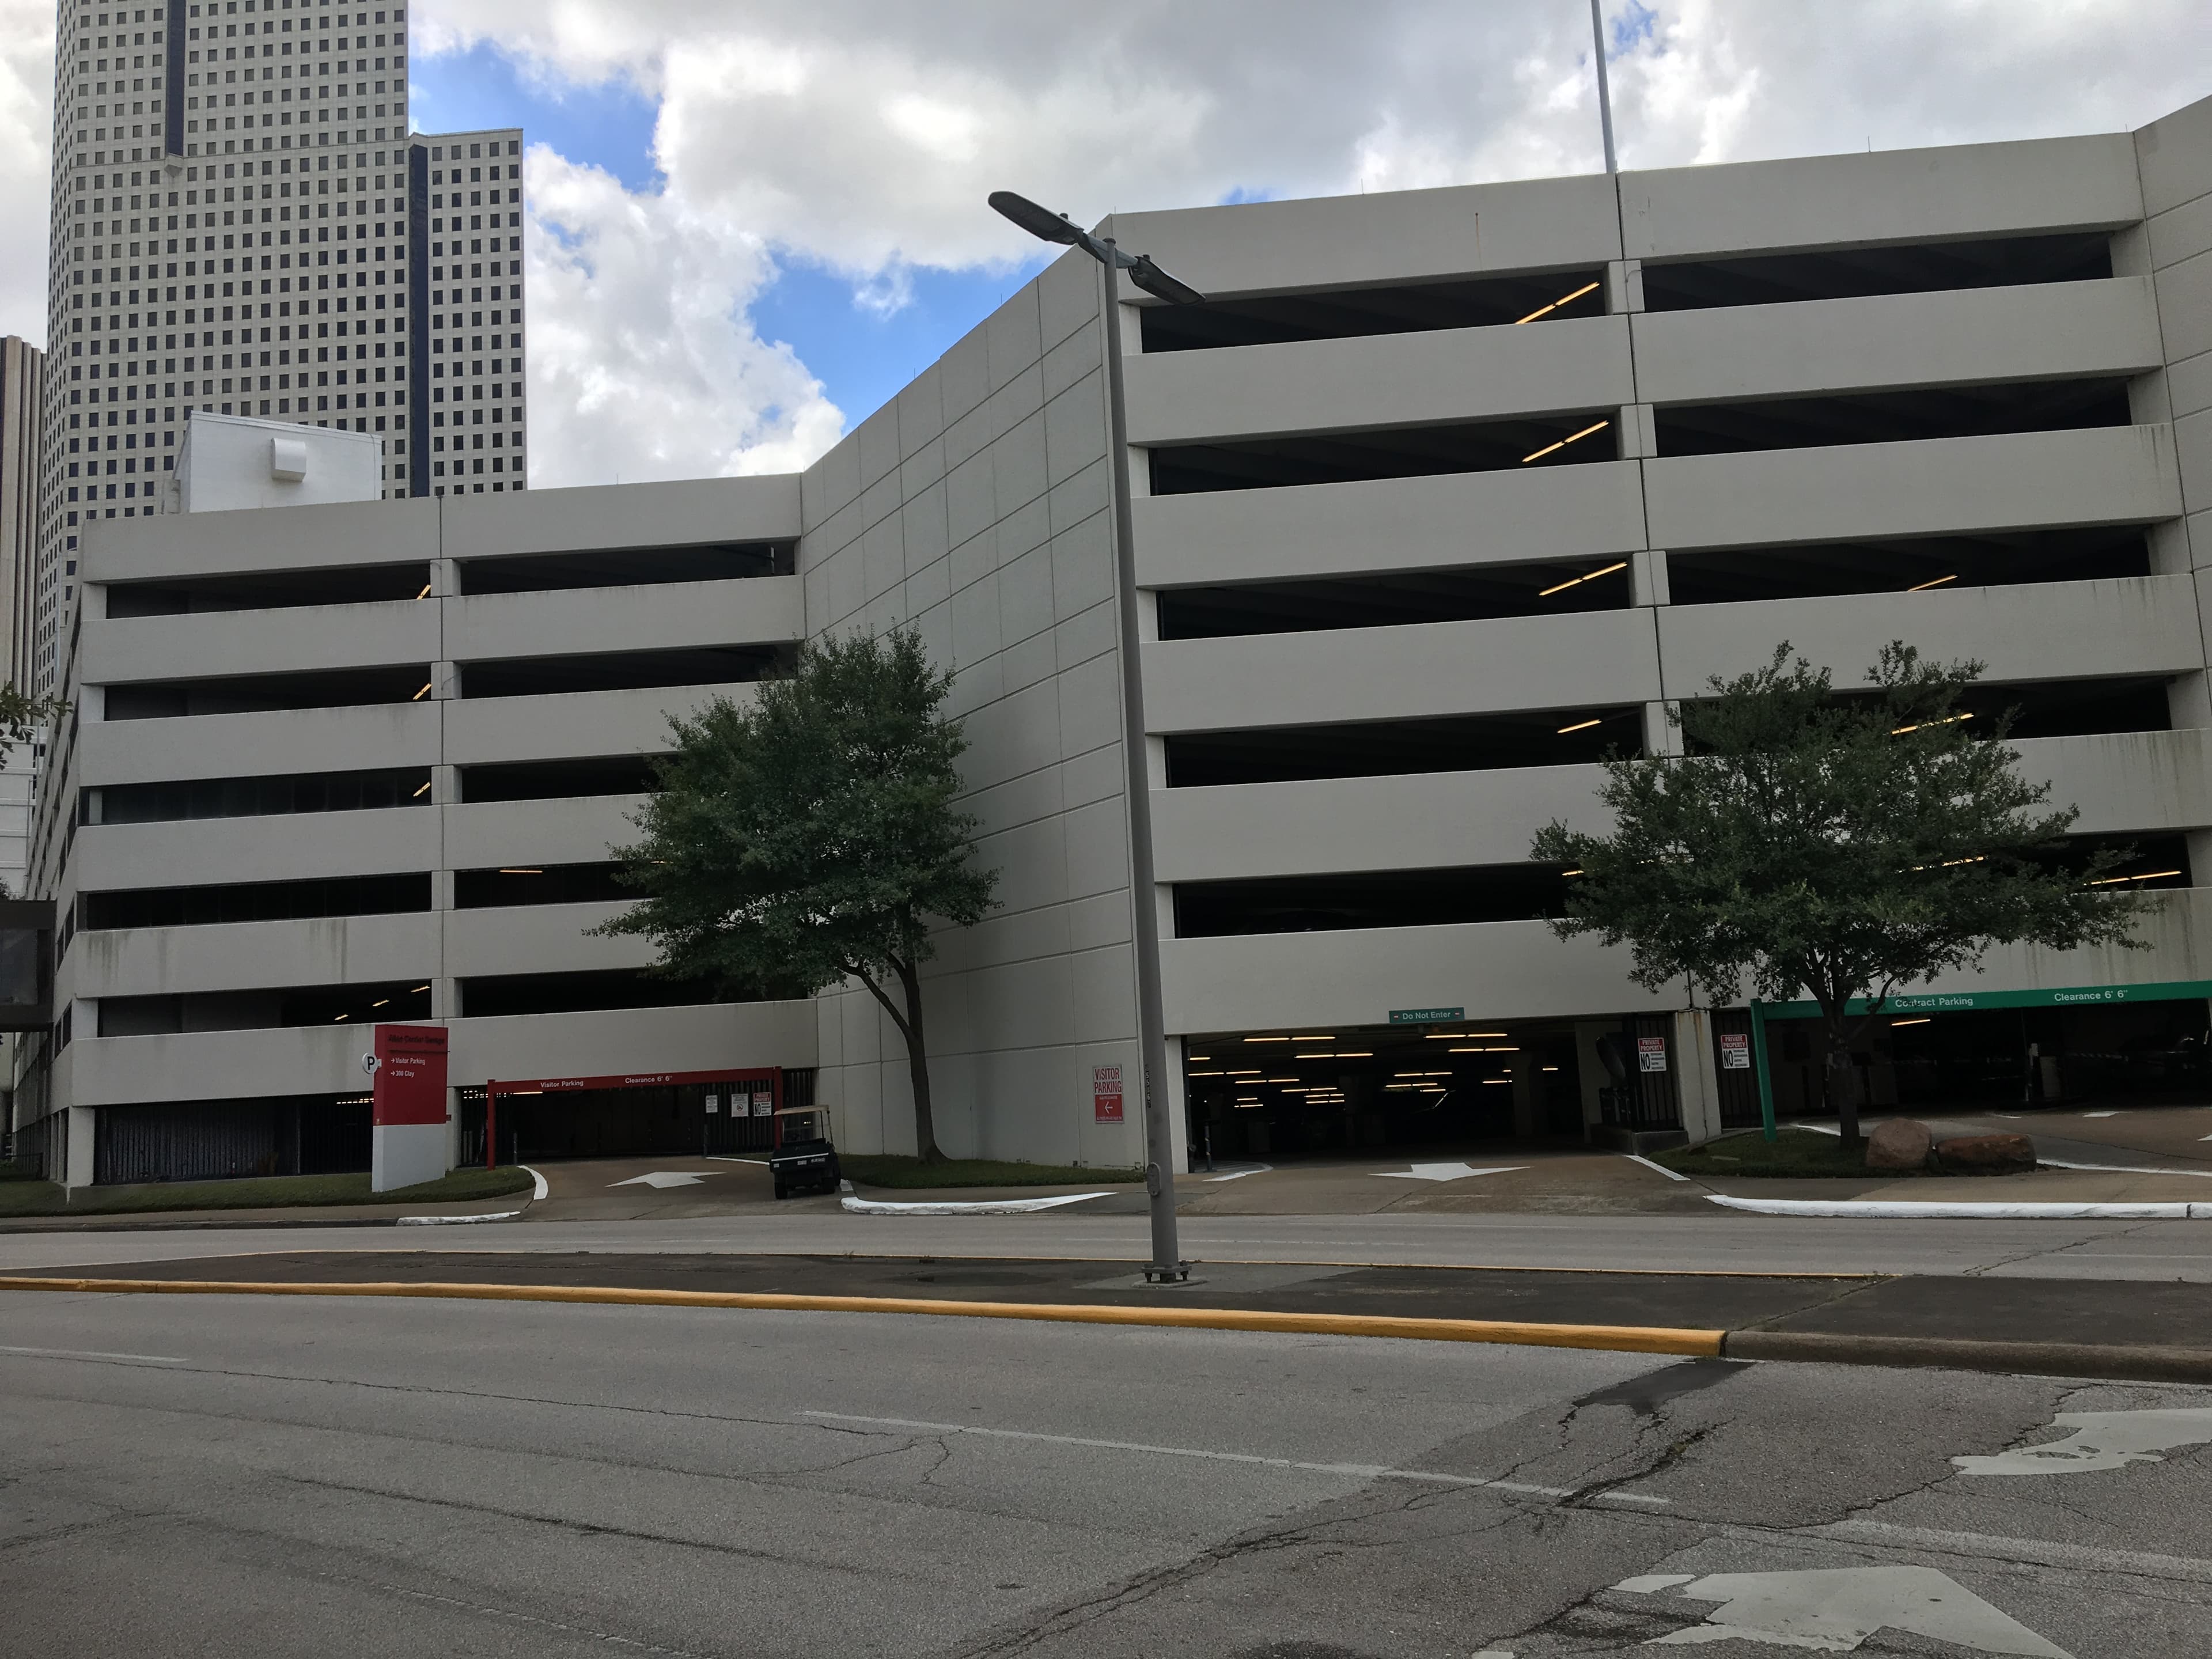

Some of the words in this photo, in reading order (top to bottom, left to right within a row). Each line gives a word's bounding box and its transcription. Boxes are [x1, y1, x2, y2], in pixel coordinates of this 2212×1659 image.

[1895, 997, 1936, 1007] Contract
[1939, 997, 1974, 1007] Parking
[2054, 991, 2101, 1002] Clearance
[2104, 990, 2113, 999] 6'
[368, 1056, 375, 1070] P
[410, 1057, 425, 1065] Parking
[1640, 1053, 1650, 1070] NO
[1724, 1050, 1733, 1067] NO
[625, 1075, 654, 1084] Clearance
[1095, 1067, 1120, 1080] VISITOR
[562, 1080, 584, 1088] Parking
[1094, 1081, 1122, 1093] PARKING
